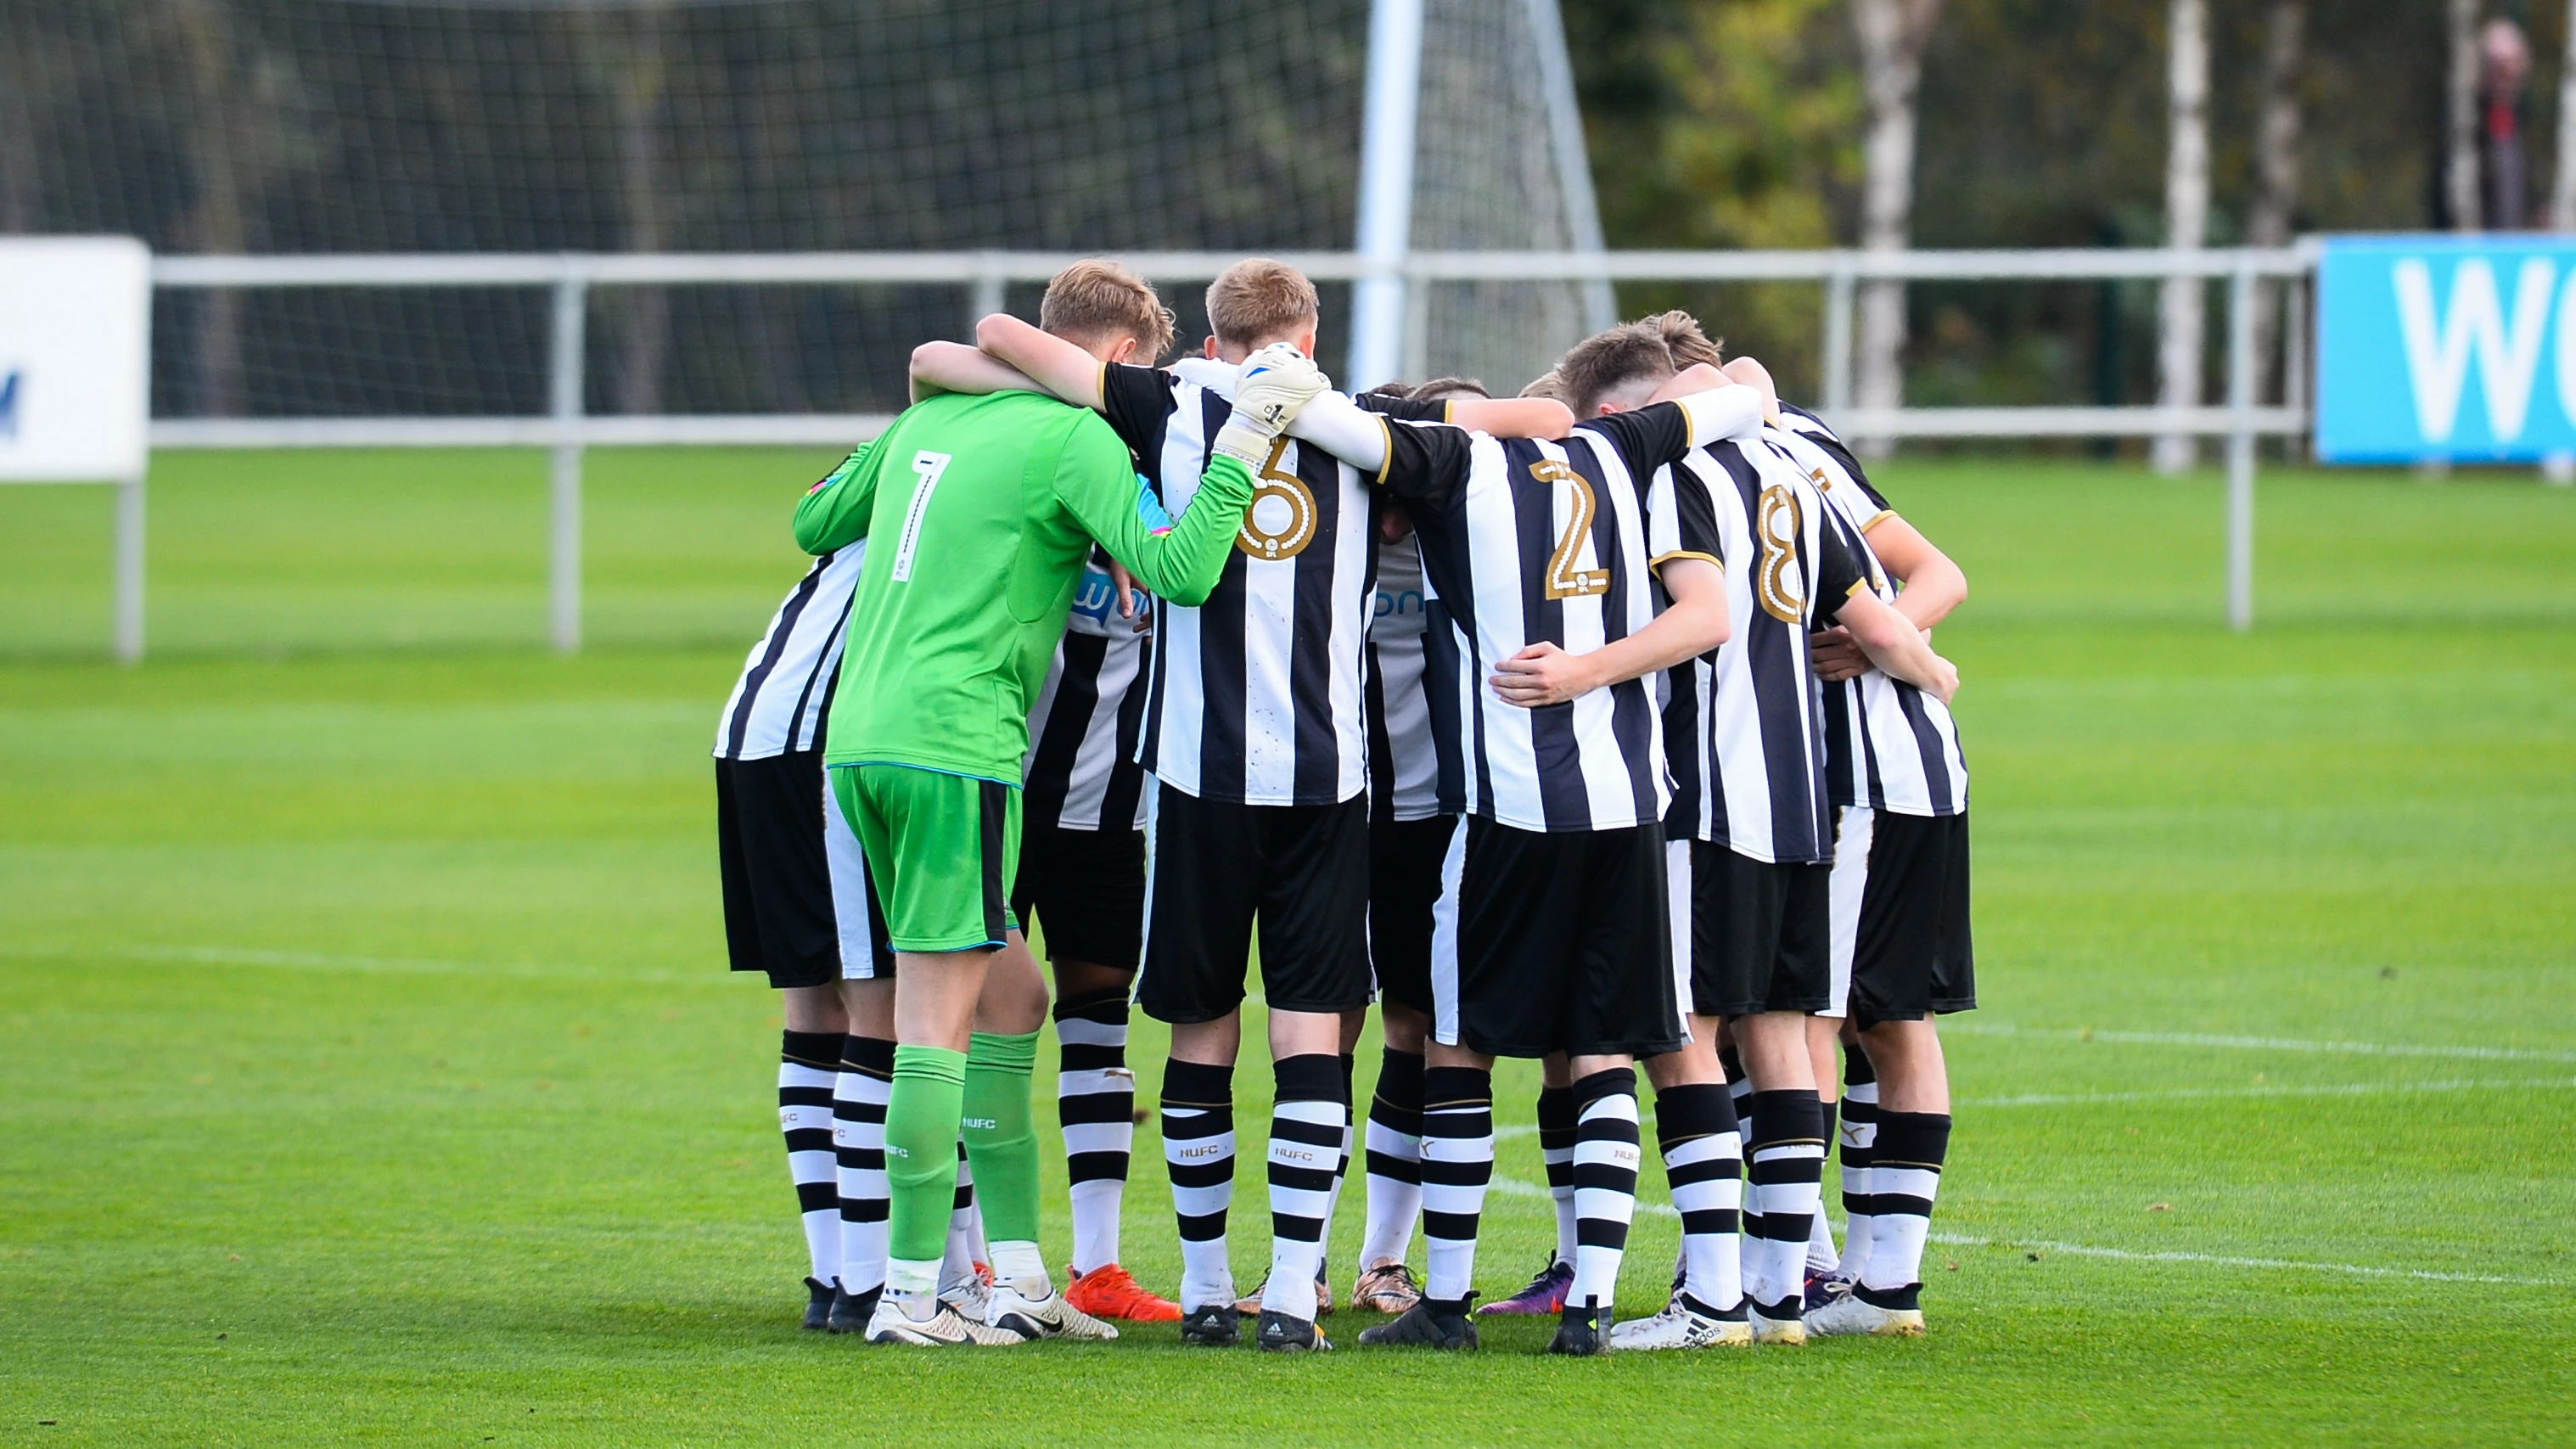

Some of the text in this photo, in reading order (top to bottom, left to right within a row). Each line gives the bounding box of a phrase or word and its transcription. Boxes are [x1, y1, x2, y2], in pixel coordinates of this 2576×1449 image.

[2392, 256, 2576, 444] W
[1235, 433, 1317, 561] 6
[1529, 458, 1611, 601] 2
[1758, 484, 1806, 625] 8
[1180, 1144, 1219, 1159] NUFC
[1275, 1146, 1314, 1162] NUFC
